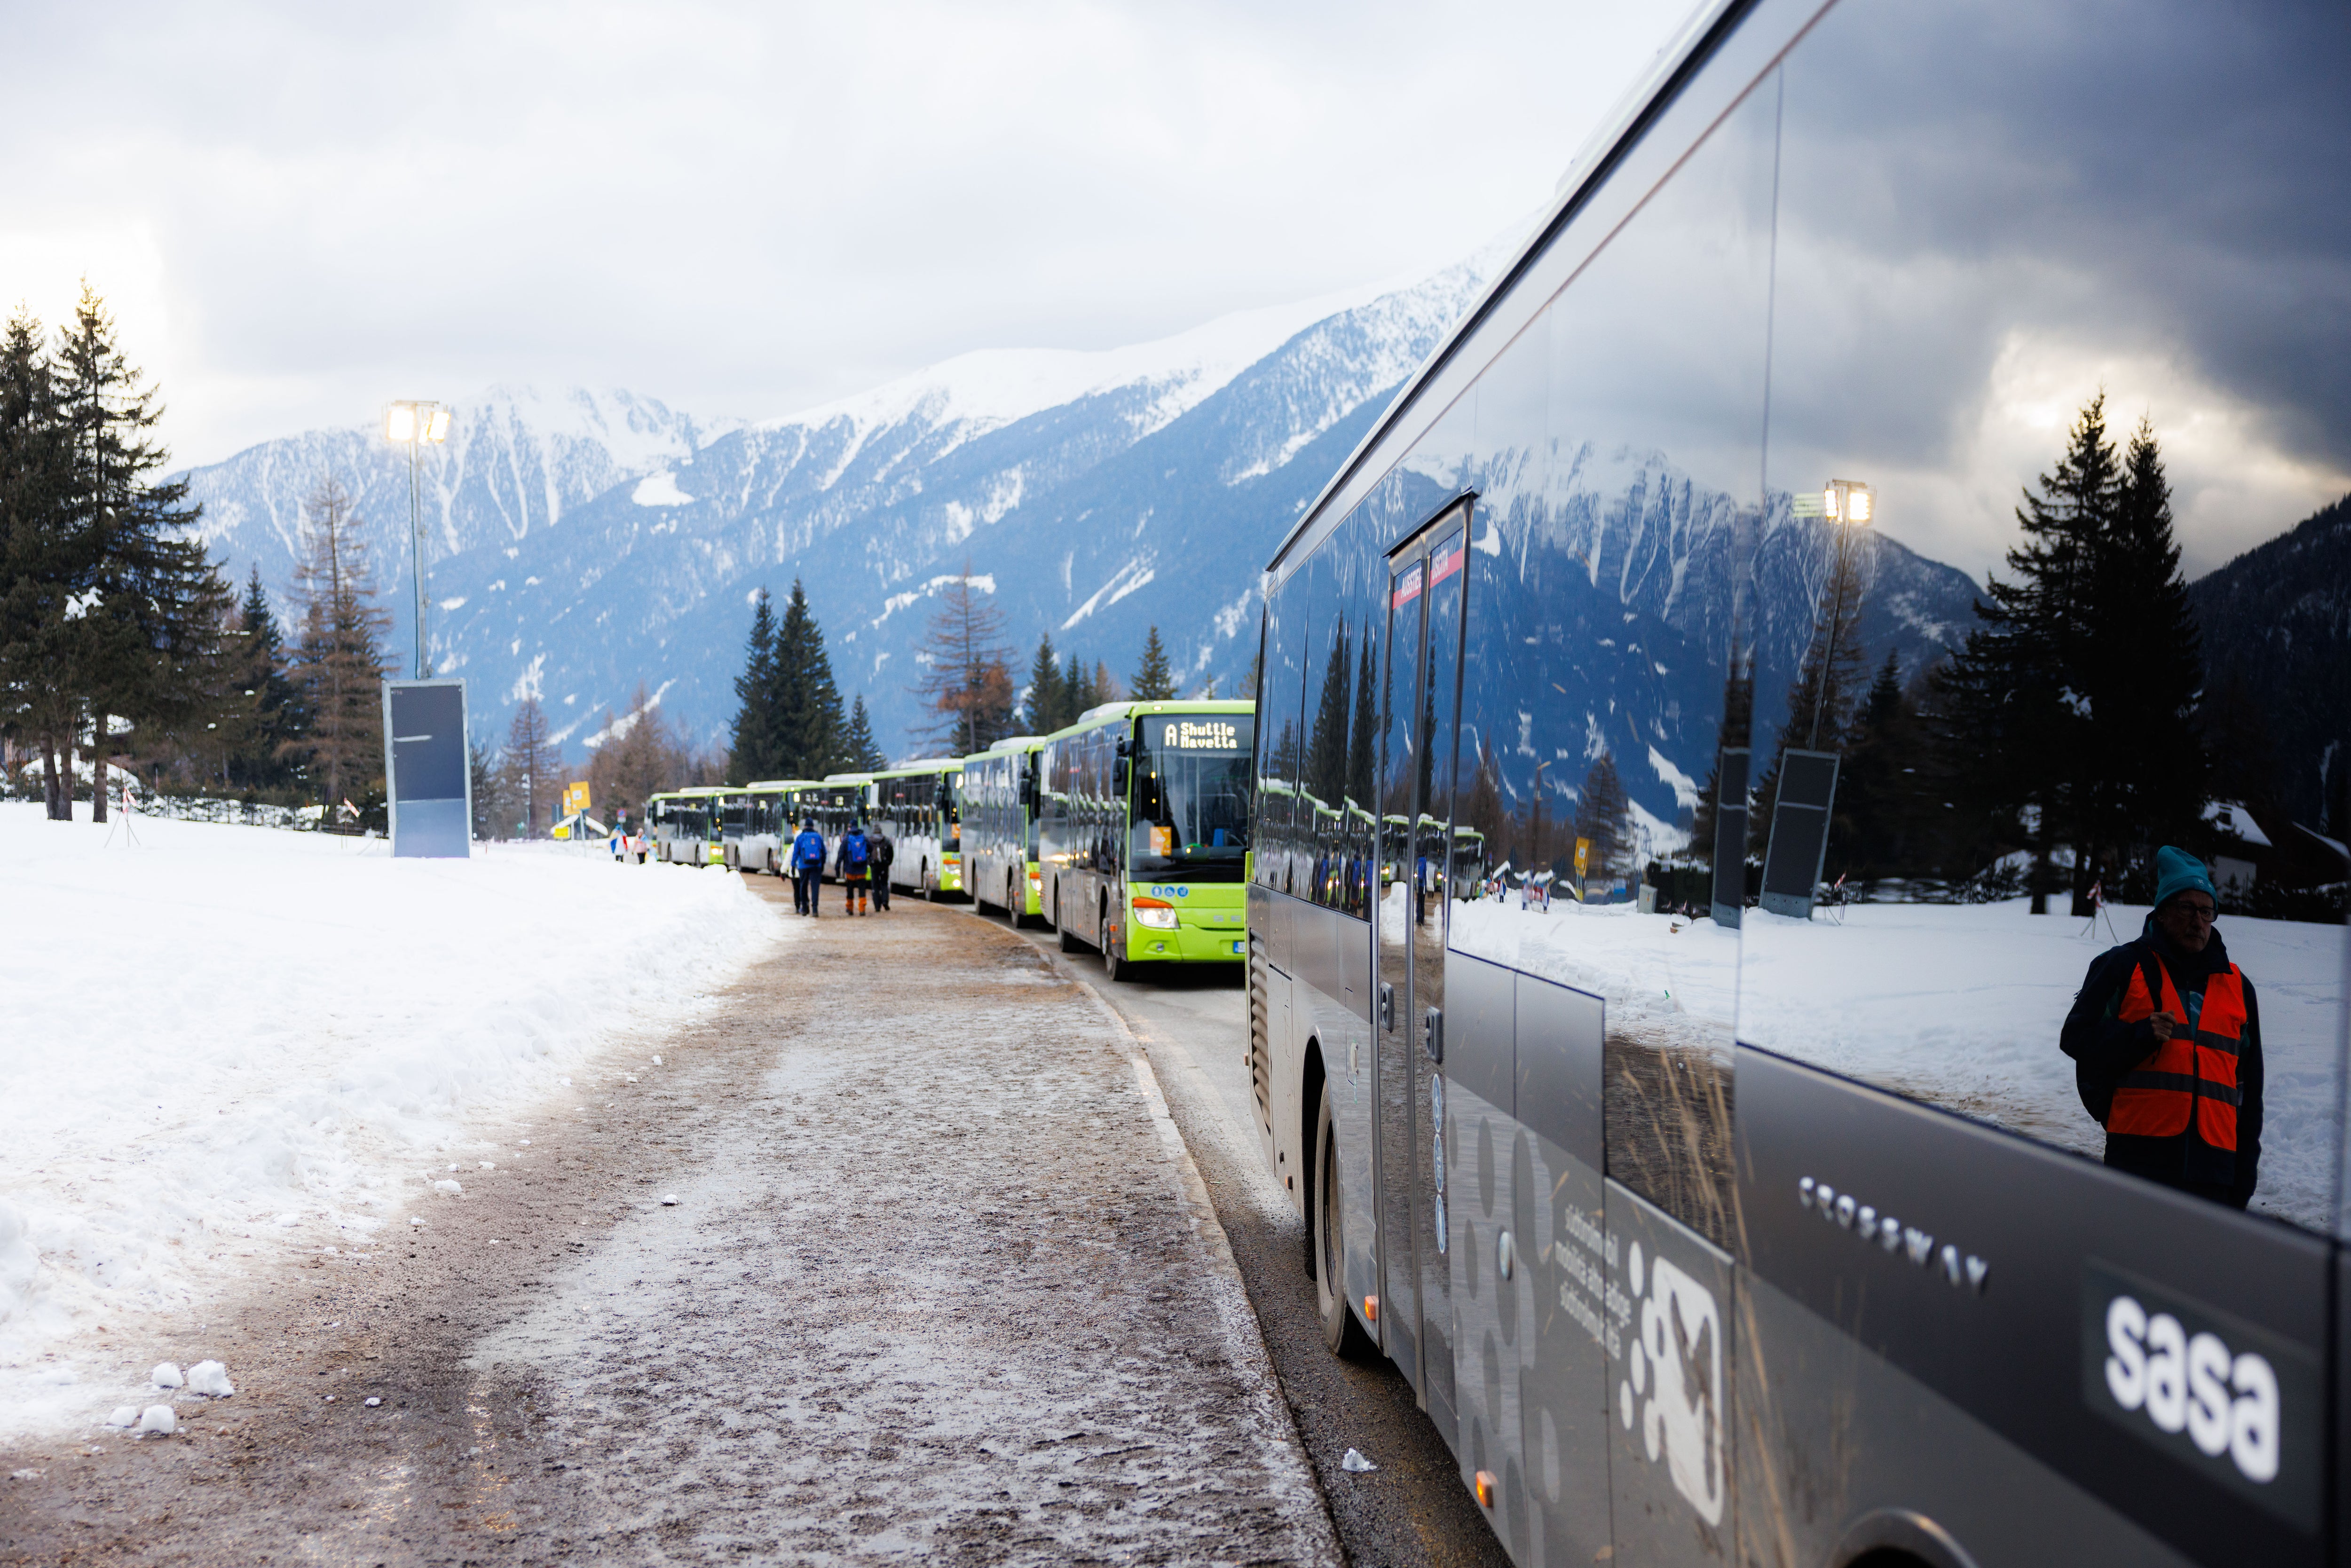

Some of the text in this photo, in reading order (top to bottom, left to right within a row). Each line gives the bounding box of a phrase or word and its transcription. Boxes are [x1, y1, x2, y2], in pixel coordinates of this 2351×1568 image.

[1432, 549, 1448, 580] USCITA
[1165, 724, 1177, 746] A
[1180, 722, 1235, 736] Shuttle
[1180, 735, 1238, 749] Navetta
[2105, 1296, 2280, 1482] sasa
